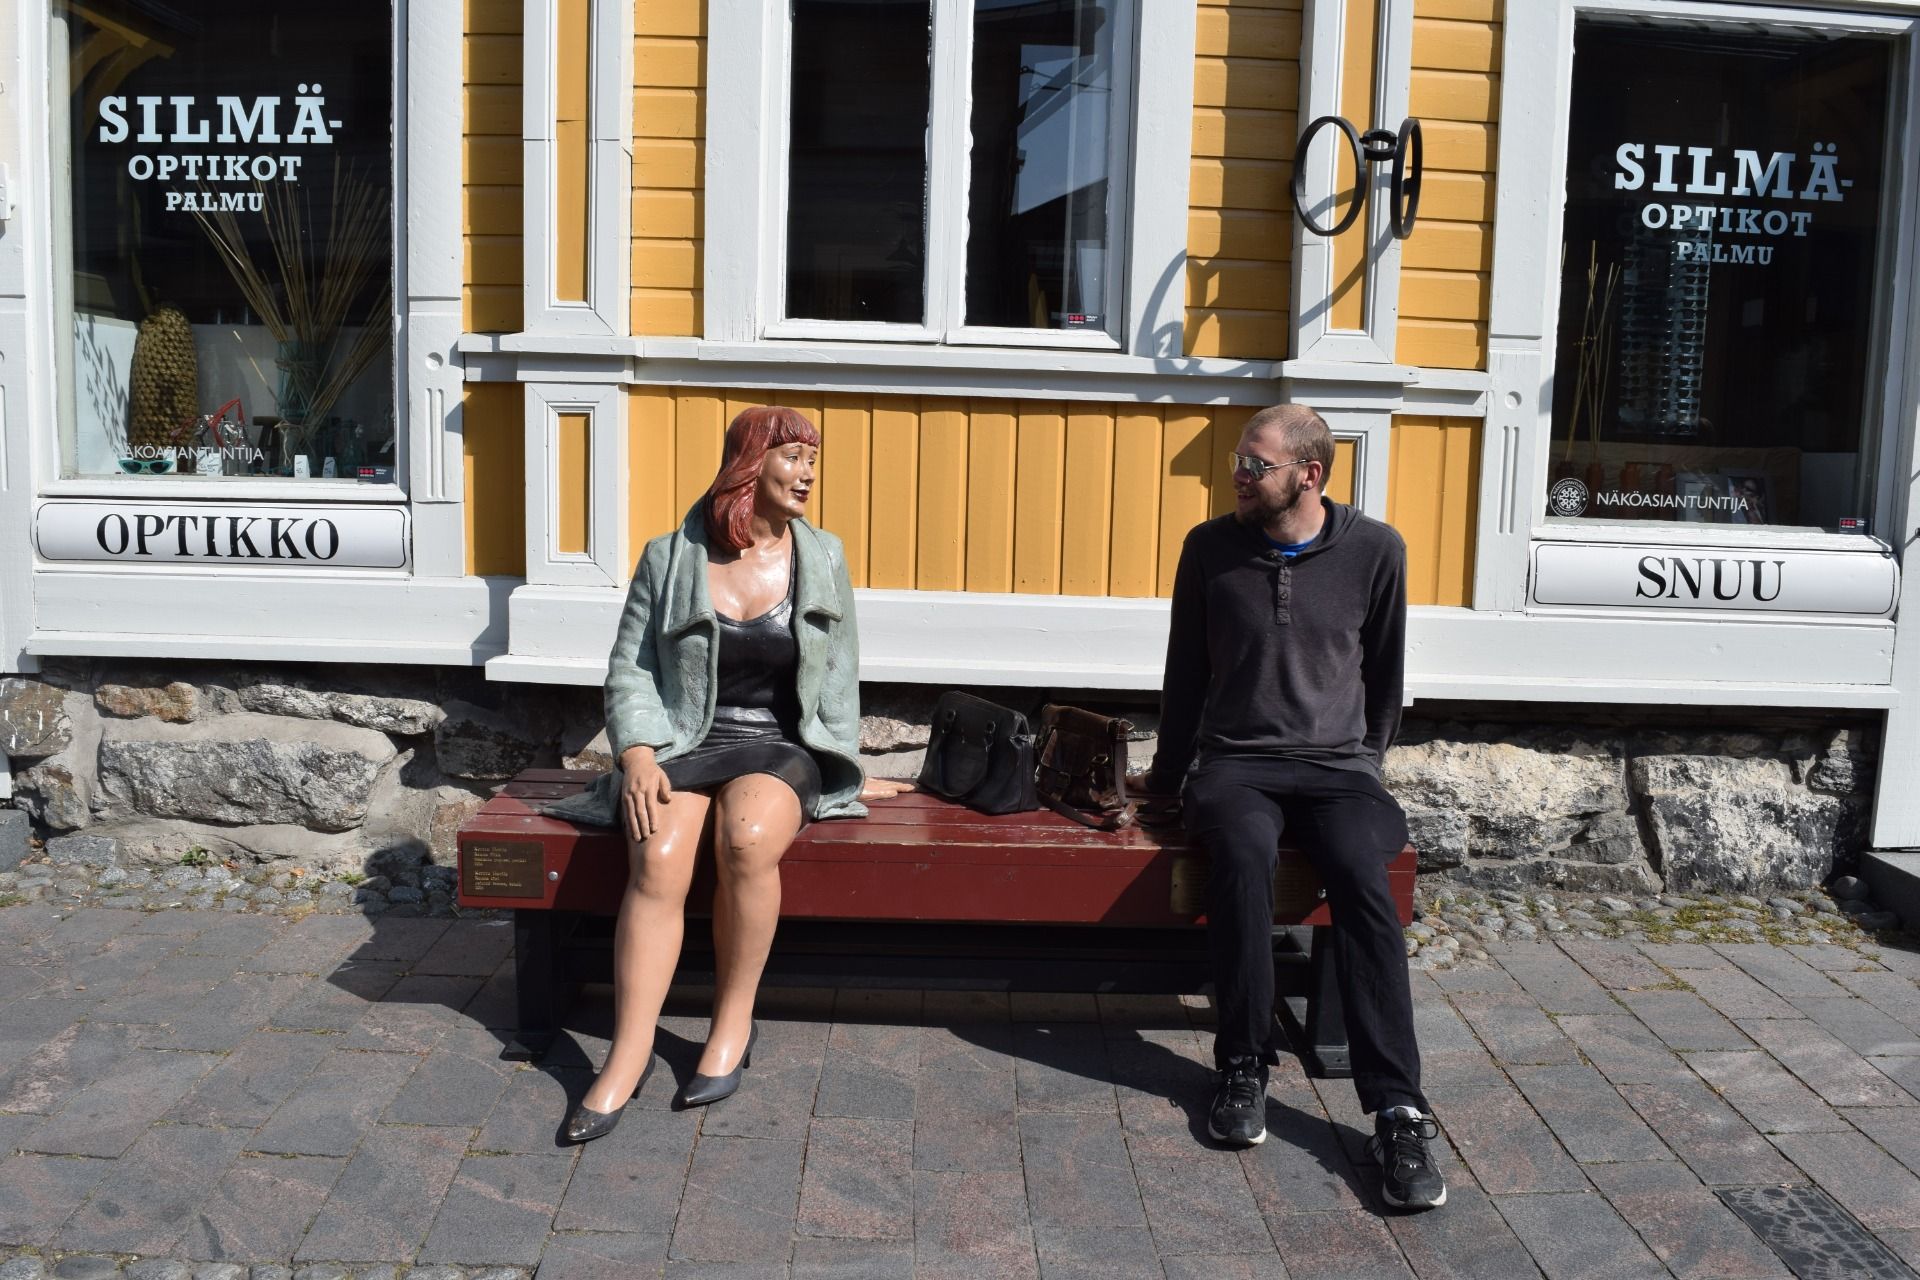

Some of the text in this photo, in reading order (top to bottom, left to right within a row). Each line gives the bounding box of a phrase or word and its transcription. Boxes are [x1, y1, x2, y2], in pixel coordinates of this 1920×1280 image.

[98, 83, 343, 144] SILMÄ-
[128, 154, 303, 183] OPTIKOT
[1614, 142, 1853, 202] SILMÄ-
[164, 191, 265, 213] PALMU
[1640, 203, 1812, 237] OPTIKOT
[1676, 241, 1774, 265] PALMU
[1596, 489, 1750, 515] NÄKÖASIANTUNTIJA
[96, 513, 340, 560] OPTIKKO
[1635, 555, 1786, 602] SNUU
